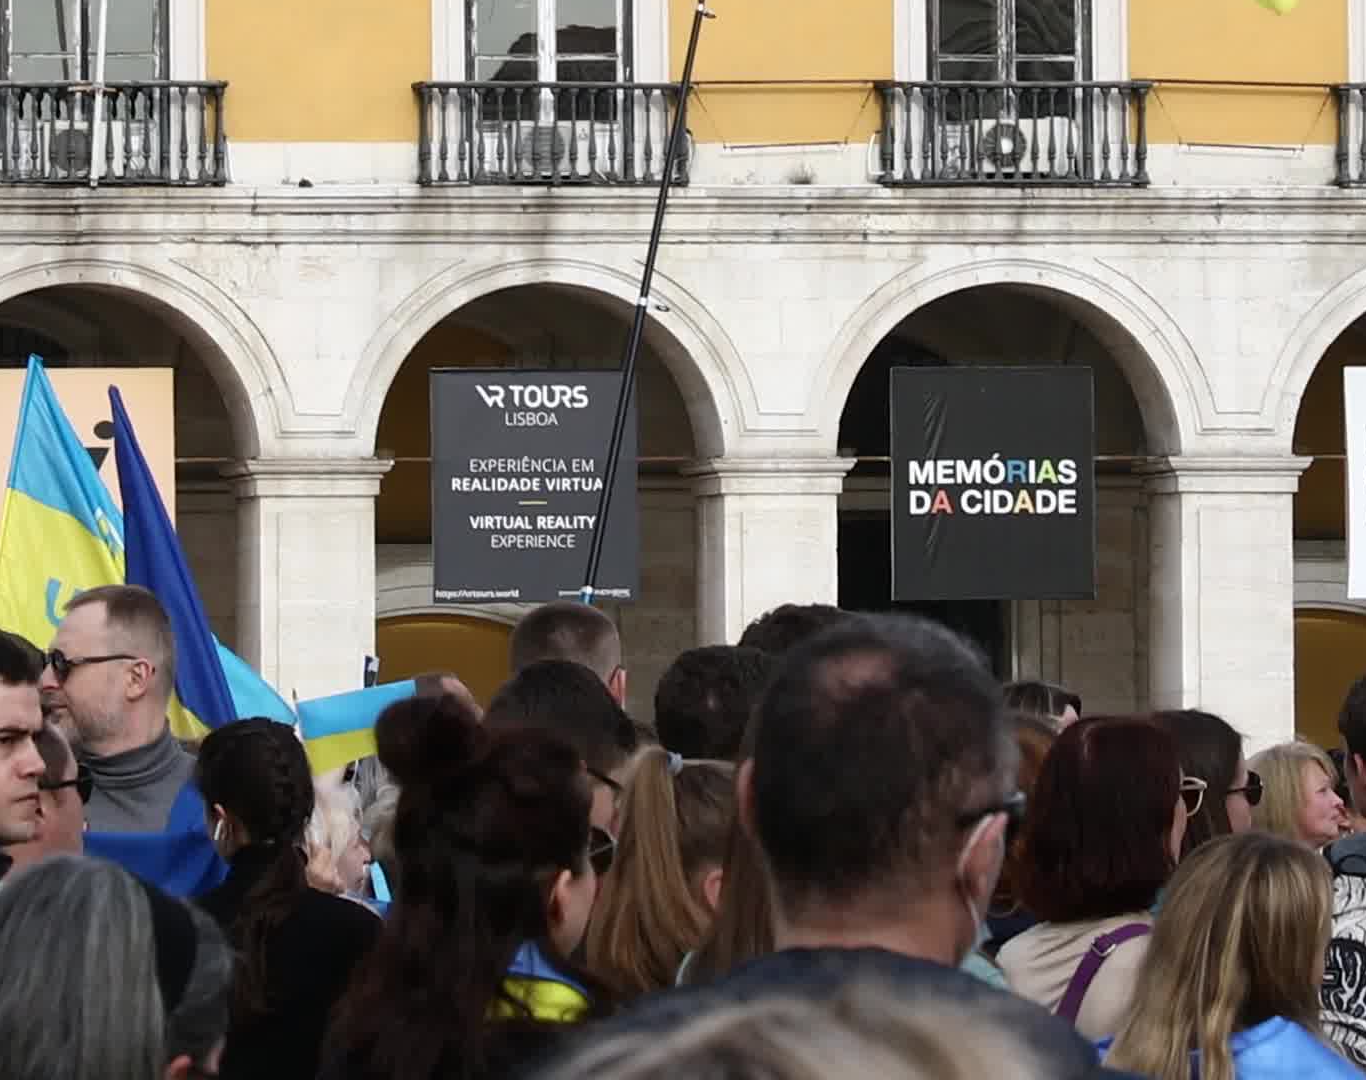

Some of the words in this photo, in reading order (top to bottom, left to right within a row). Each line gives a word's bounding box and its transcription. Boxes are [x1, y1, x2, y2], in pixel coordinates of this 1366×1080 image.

[475, 385, 505, 408] VR
[508, 385, 589, 408] TOURS
[504, 412, 558, 426] LISBOA
[469, 456, 567, 473] EXPERIÊNCIA
[572, 459, 595, 473] EM
[908, 453, 1077, 485] MEMÓRIAS
[451, 478, 541, 491] REALIDADE
[545, 478, 604, 491] VIRTUA
[909, 490, 953, 515] DA
[960, 489, 1077, 515] CIDADE
[469, 516, 533, 529] VIRTUAL
[536, 516, 596, 529] REALITY
[490, 534, 576, 548] EXPERIENCE
